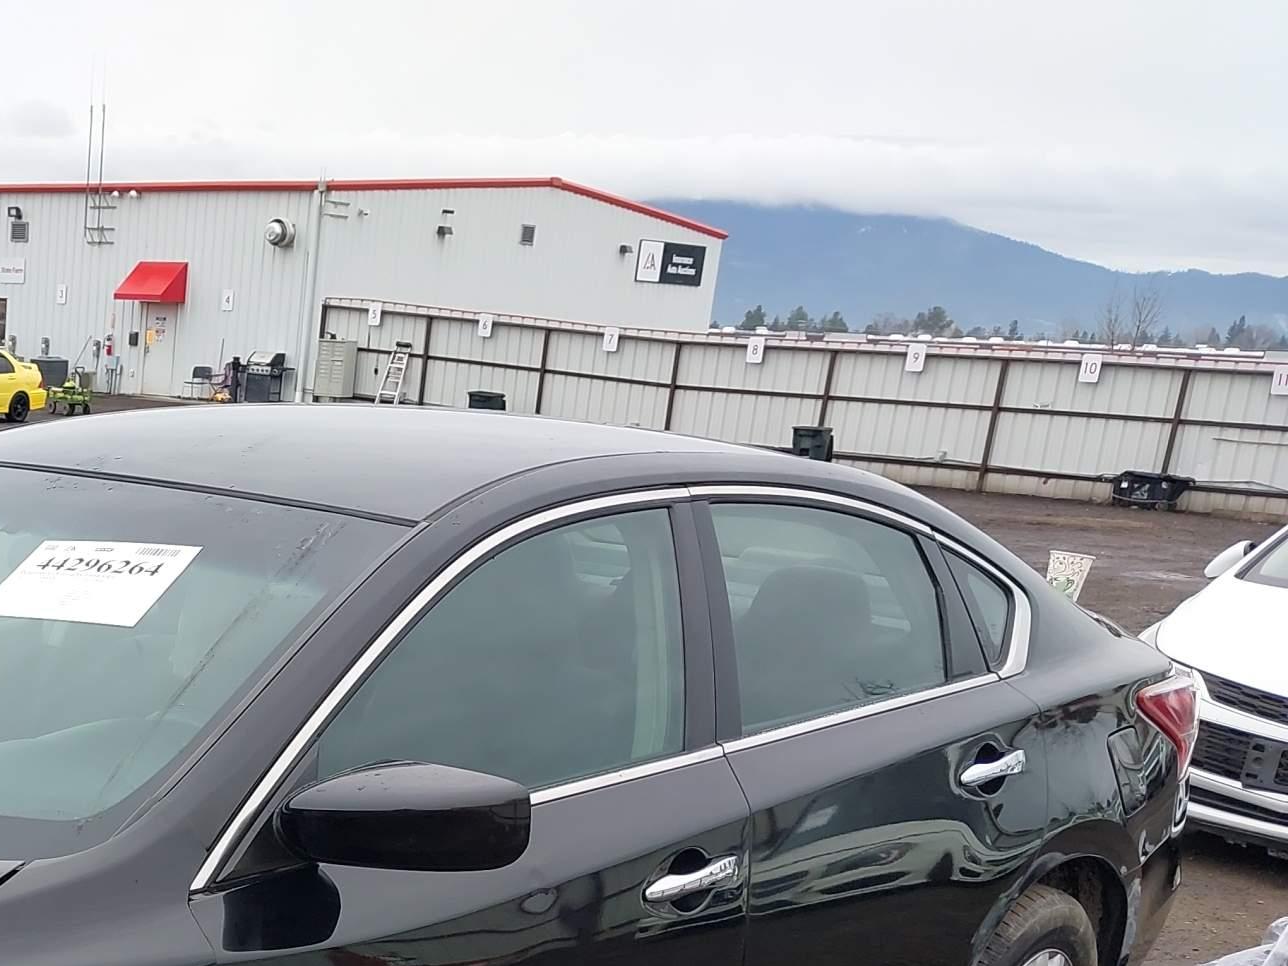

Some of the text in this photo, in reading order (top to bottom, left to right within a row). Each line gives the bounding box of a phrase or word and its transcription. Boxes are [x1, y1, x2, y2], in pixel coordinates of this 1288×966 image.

[482, 320, 488, 330] 6
[608, 333, 615, 344] 7
[752, 344, 759, 355] 8
[913, 352, 920, 364] 9
[1084, 361, 1098, 375] 10
[36, 557, 165, 576] 44296264
